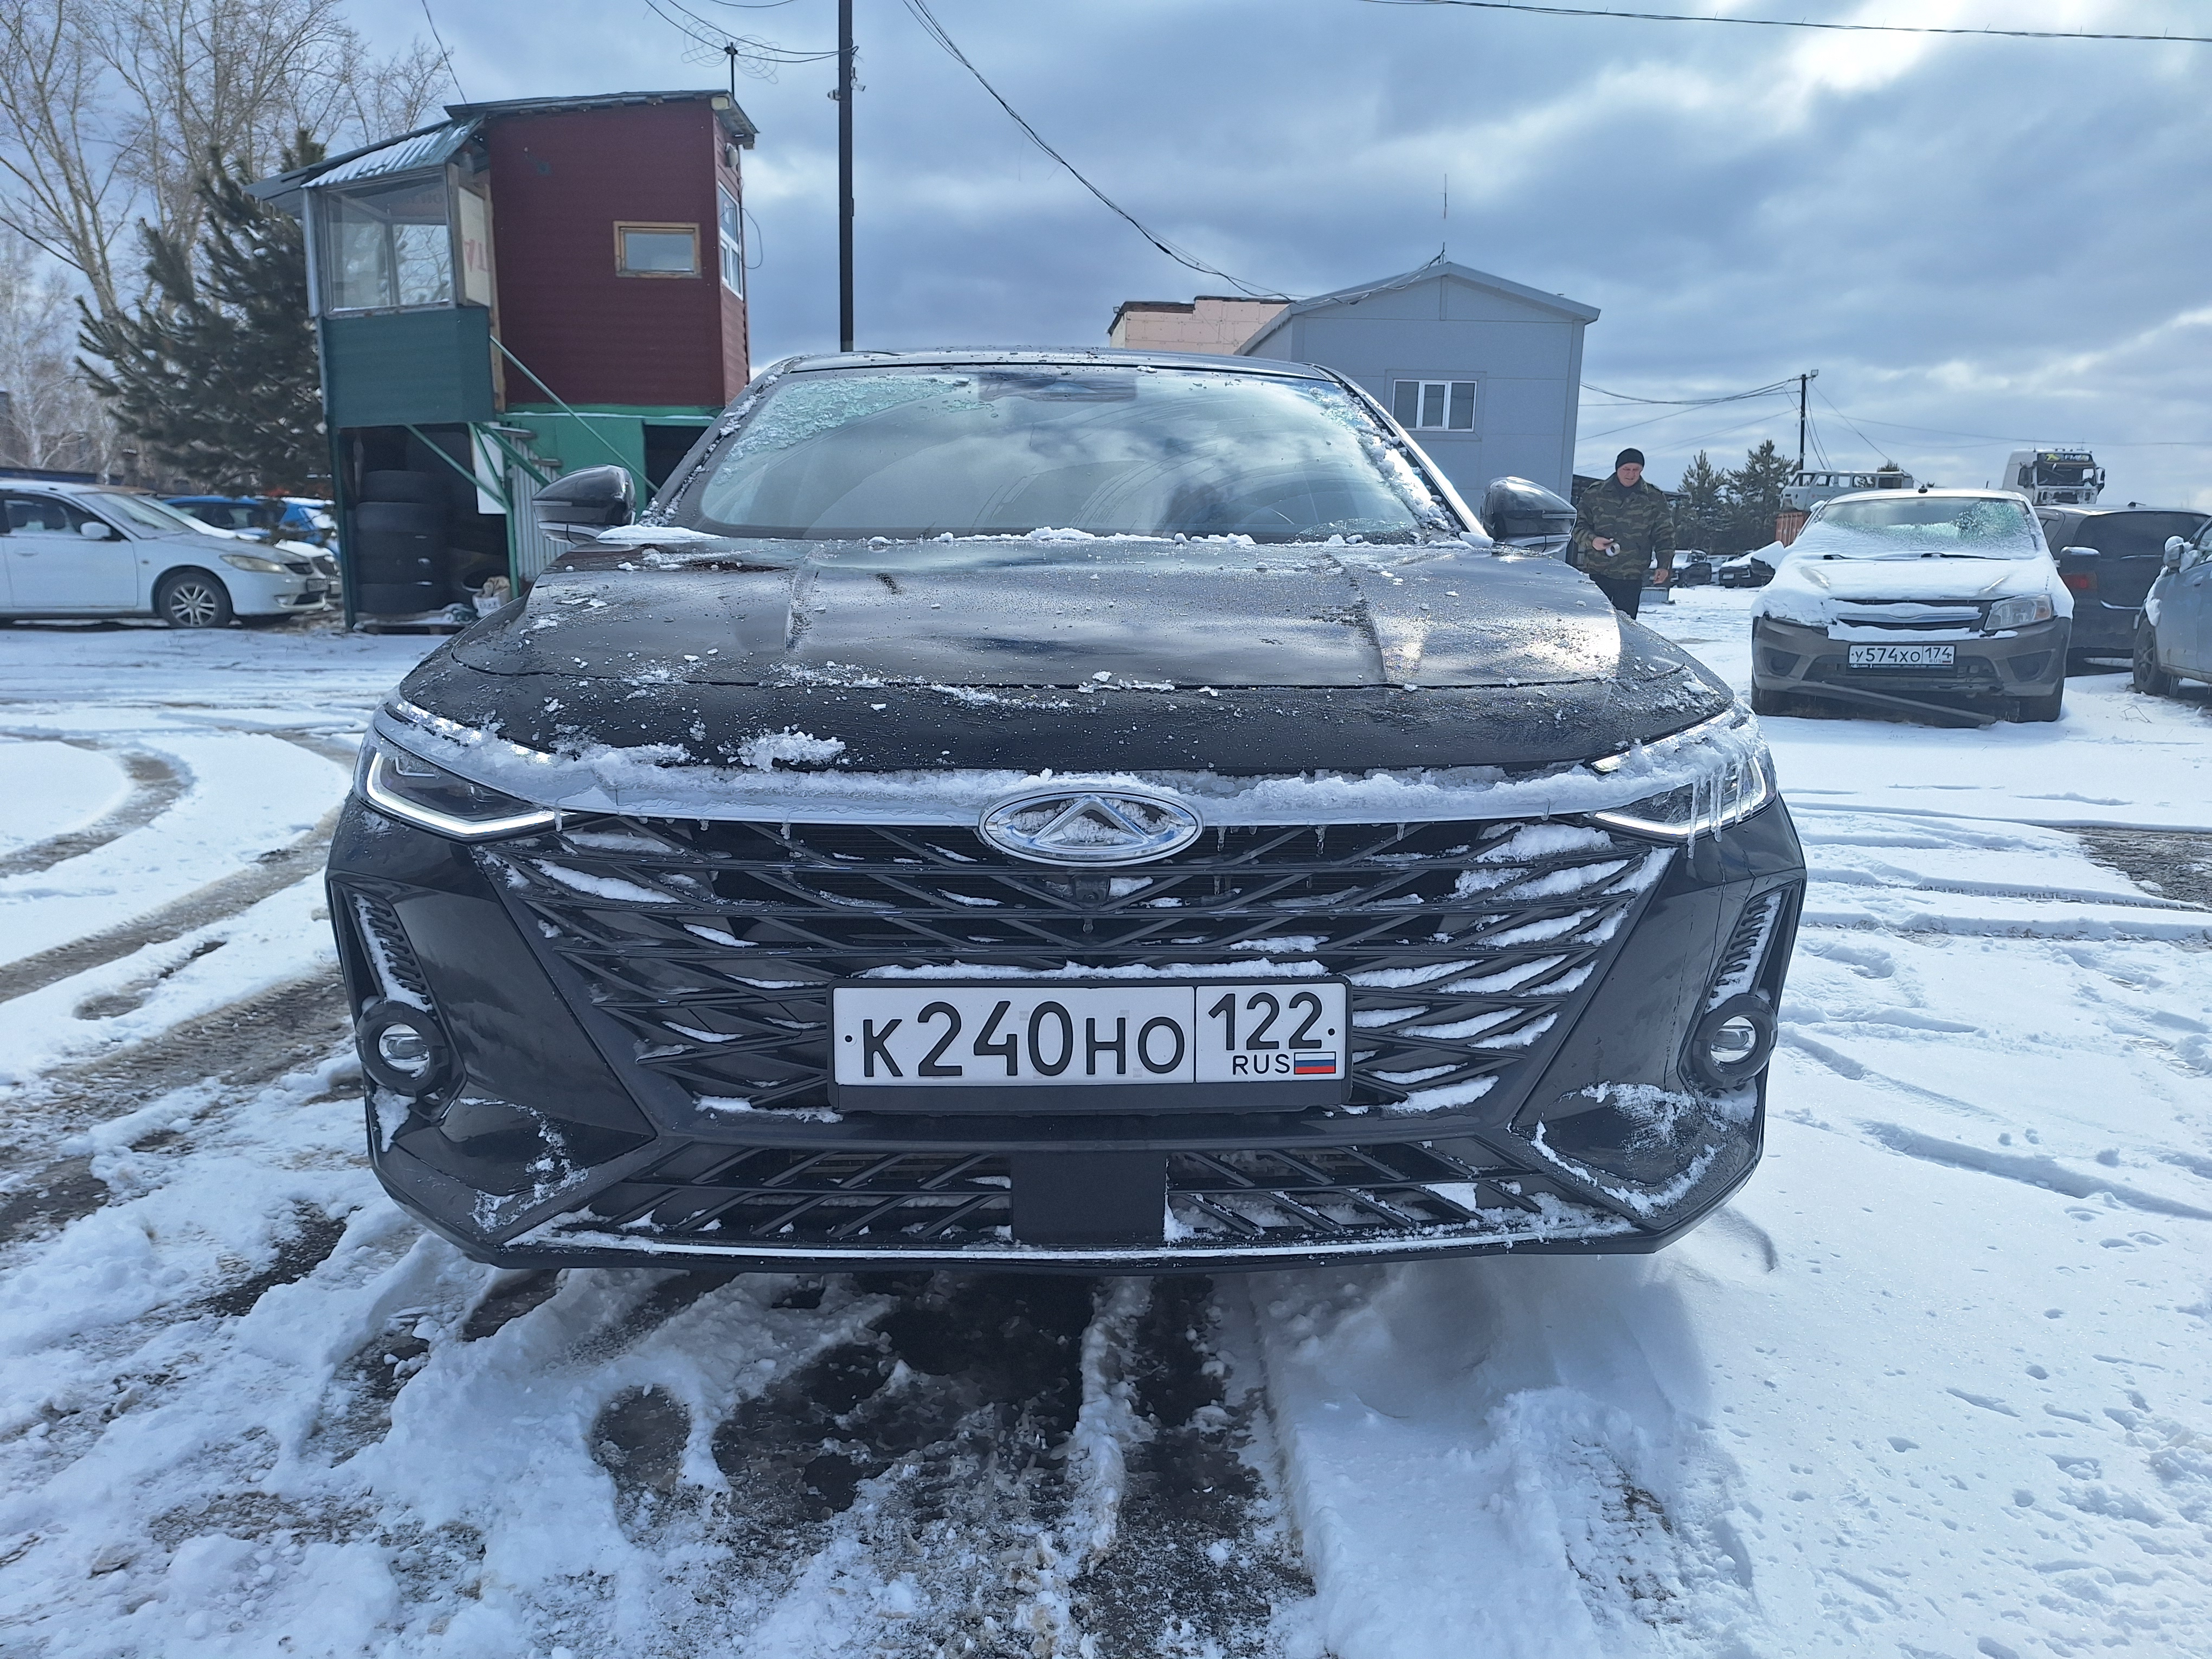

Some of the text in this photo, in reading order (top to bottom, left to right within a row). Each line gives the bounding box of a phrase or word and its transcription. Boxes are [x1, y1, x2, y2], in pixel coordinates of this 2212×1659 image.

[1855, 647, 1950, 663] У574ХО 174
[863, 992, 1323, 1078] К240НО 122
[1232, 1053, 1291, 1075] RUS
